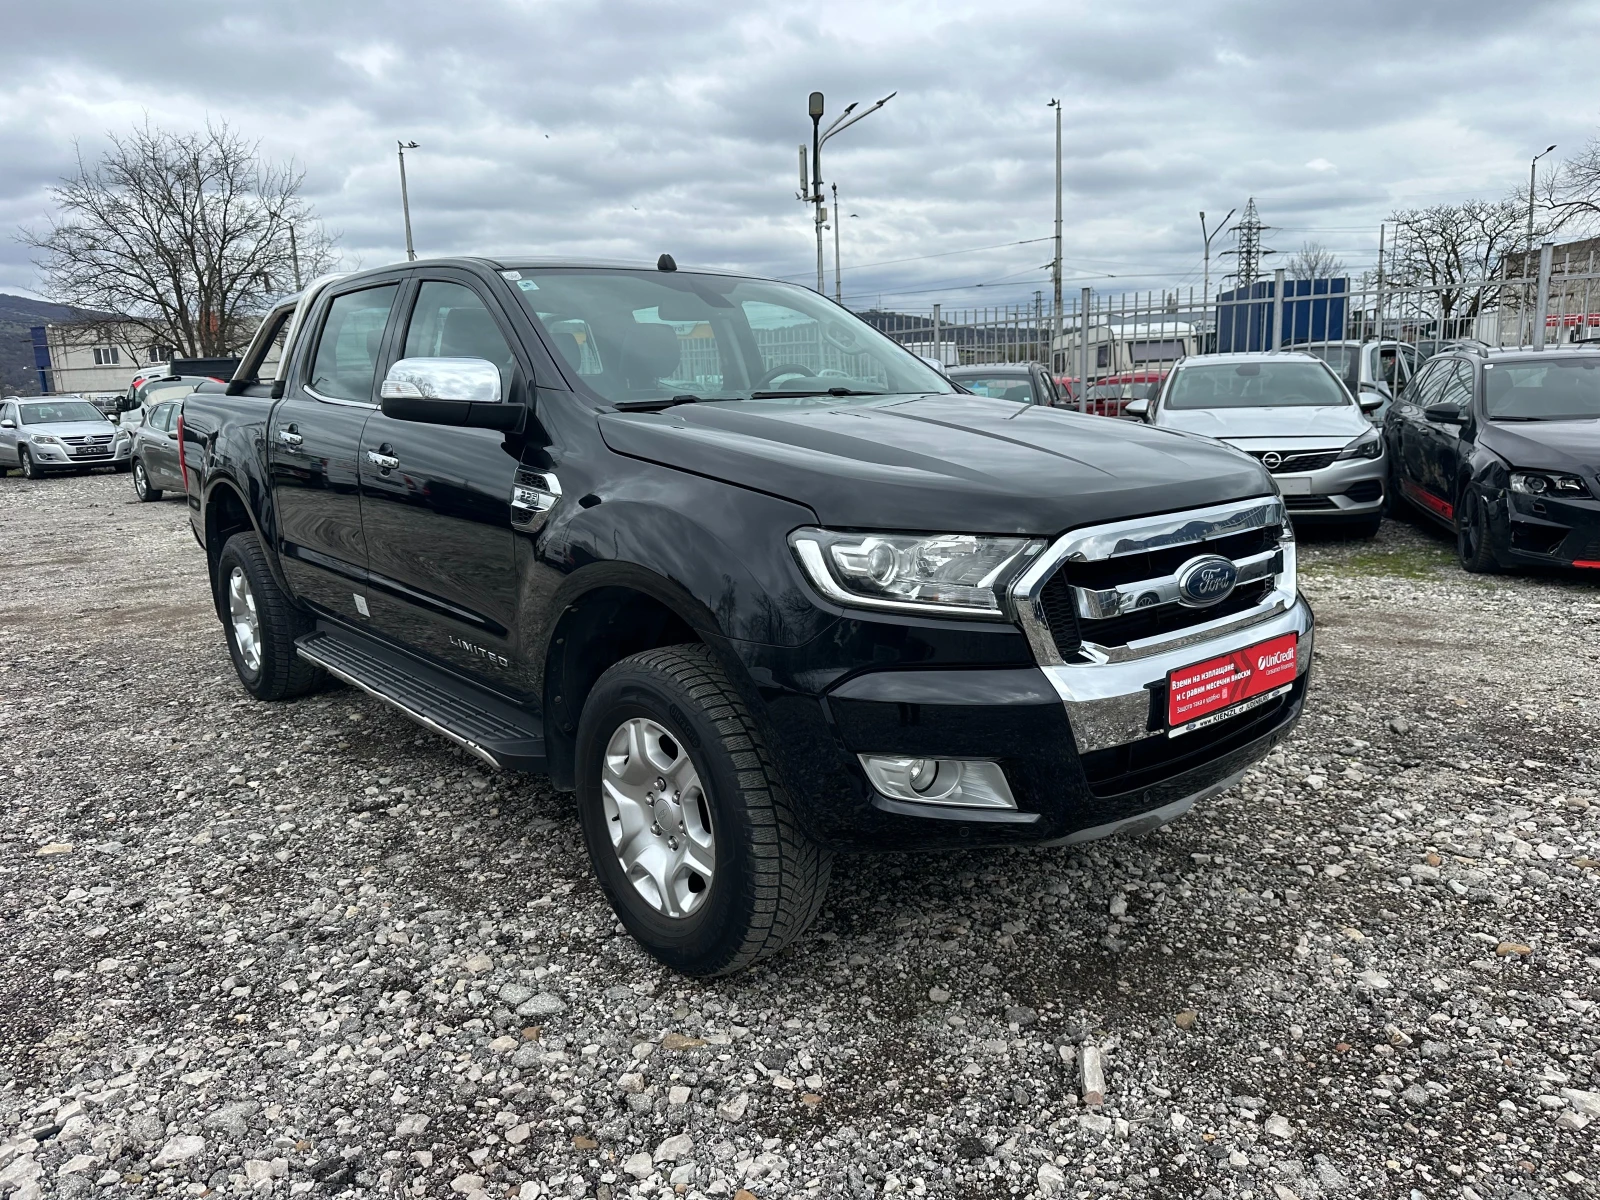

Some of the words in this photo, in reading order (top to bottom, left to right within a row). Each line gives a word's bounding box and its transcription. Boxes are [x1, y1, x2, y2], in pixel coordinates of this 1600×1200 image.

[1199, 567, 1229, 594] Ford
[448, 635, 509, 668] LIMITED
[1265, 647, 1294, 668] UniCredit
[1171, 678, 1192, 691] Вземи
[1192, 674, 1201, 683] на
[1201, 663, 1235, 680] изплащане
[1176, 693, 1181, 701] и
[1186, 686, 1205, 700] равни
[1205, 675, 1231, 691] месечни
[1231, 668, 1251, 682] вноски
